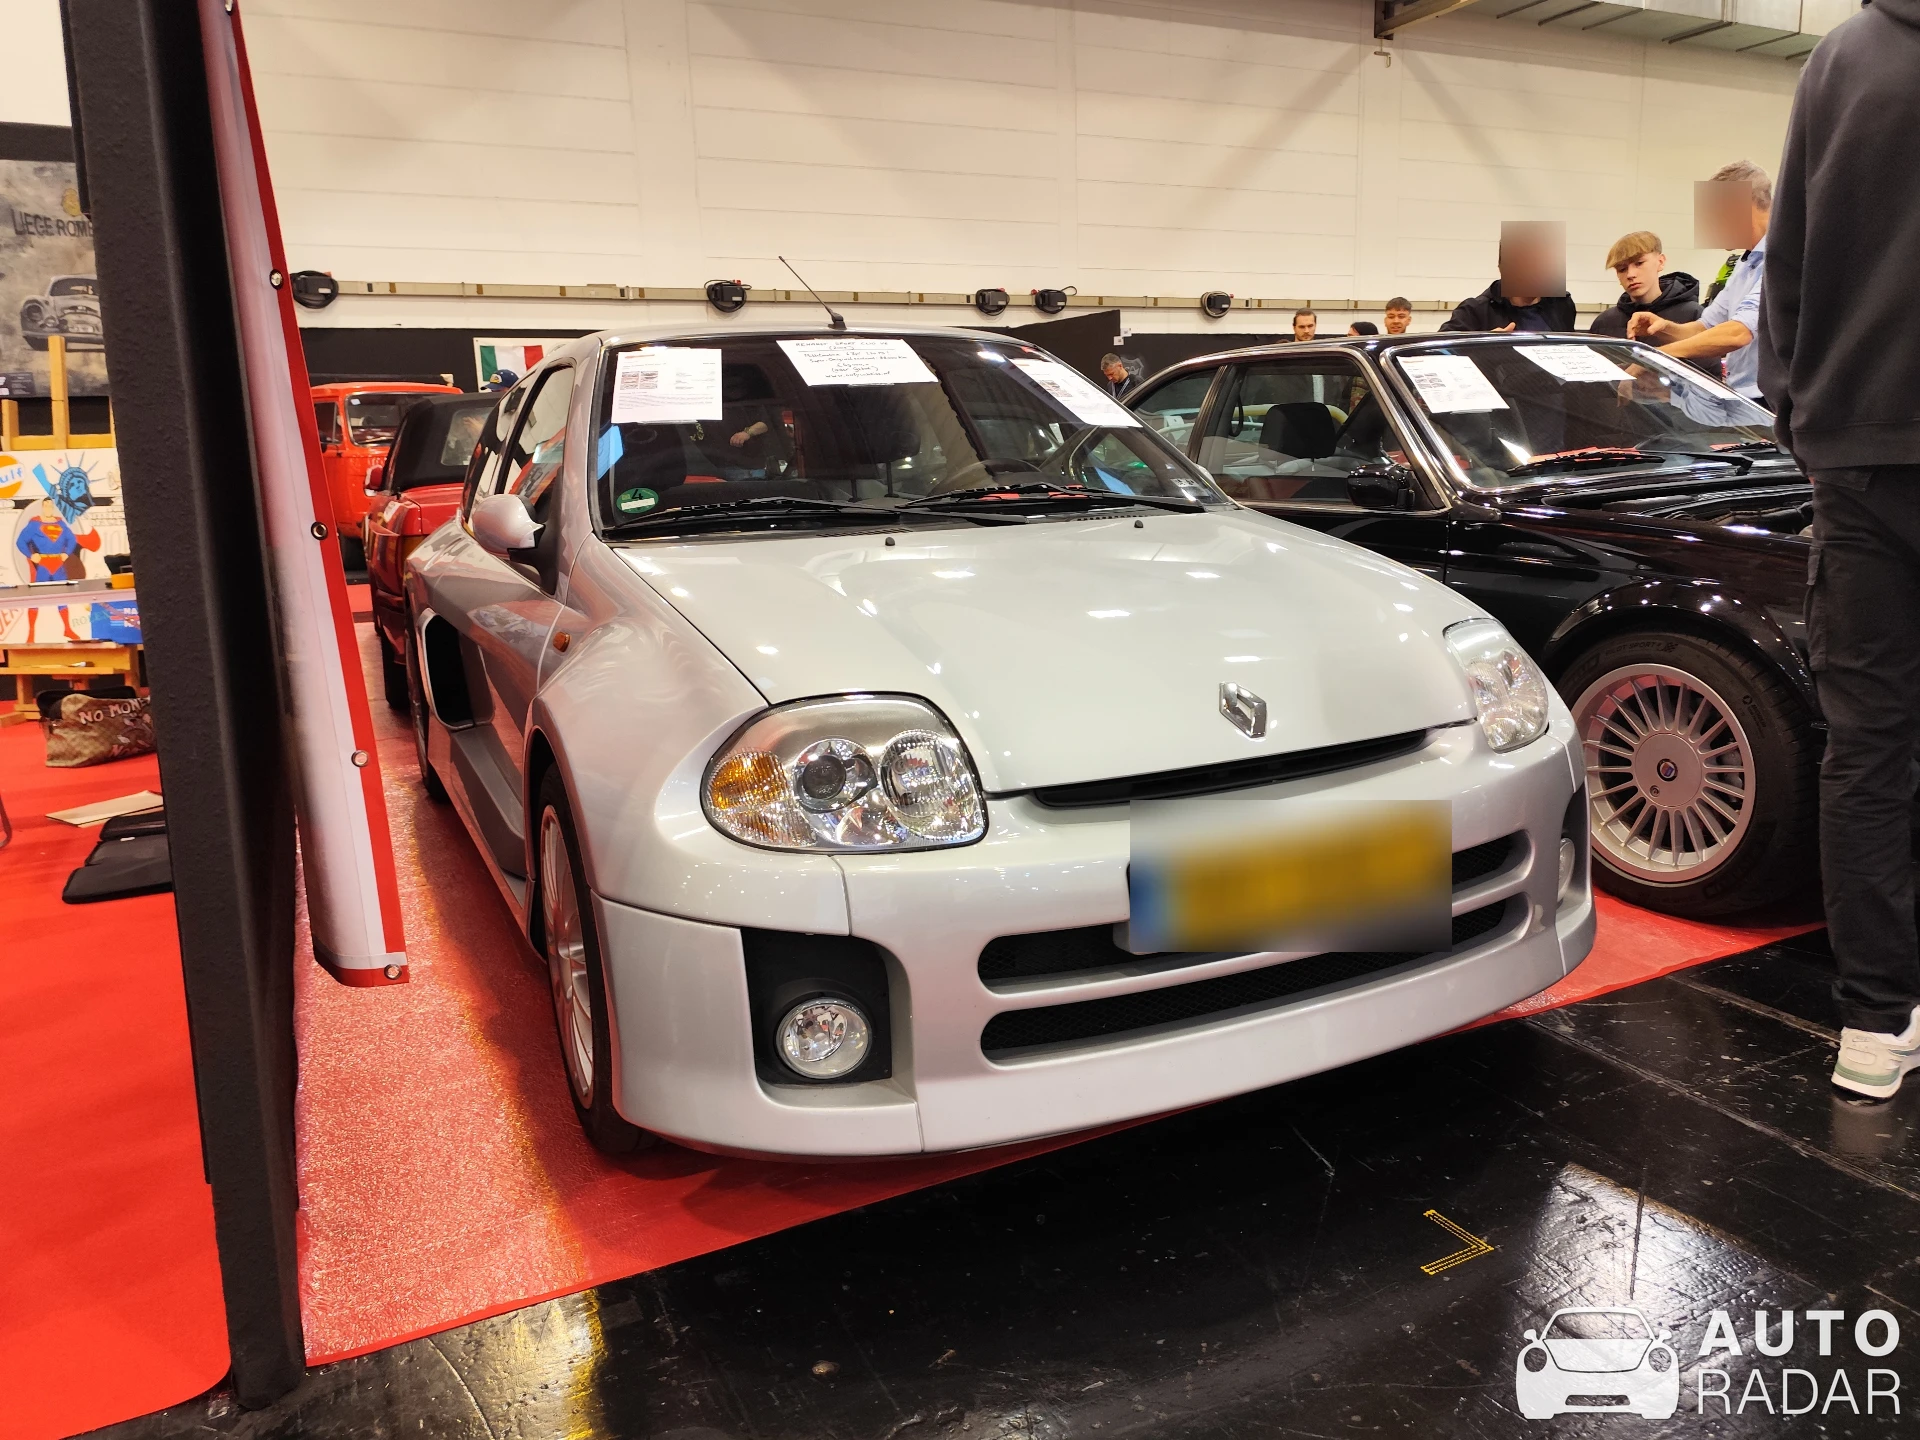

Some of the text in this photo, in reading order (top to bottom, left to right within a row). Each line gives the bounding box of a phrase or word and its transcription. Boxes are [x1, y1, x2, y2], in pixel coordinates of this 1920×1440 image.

[10, 208, 54, 236] LIEGE
[0, 467, 22, 483] ulf
[631, 488, 644, 500] 4
[79, 709, 104, 724] NO
